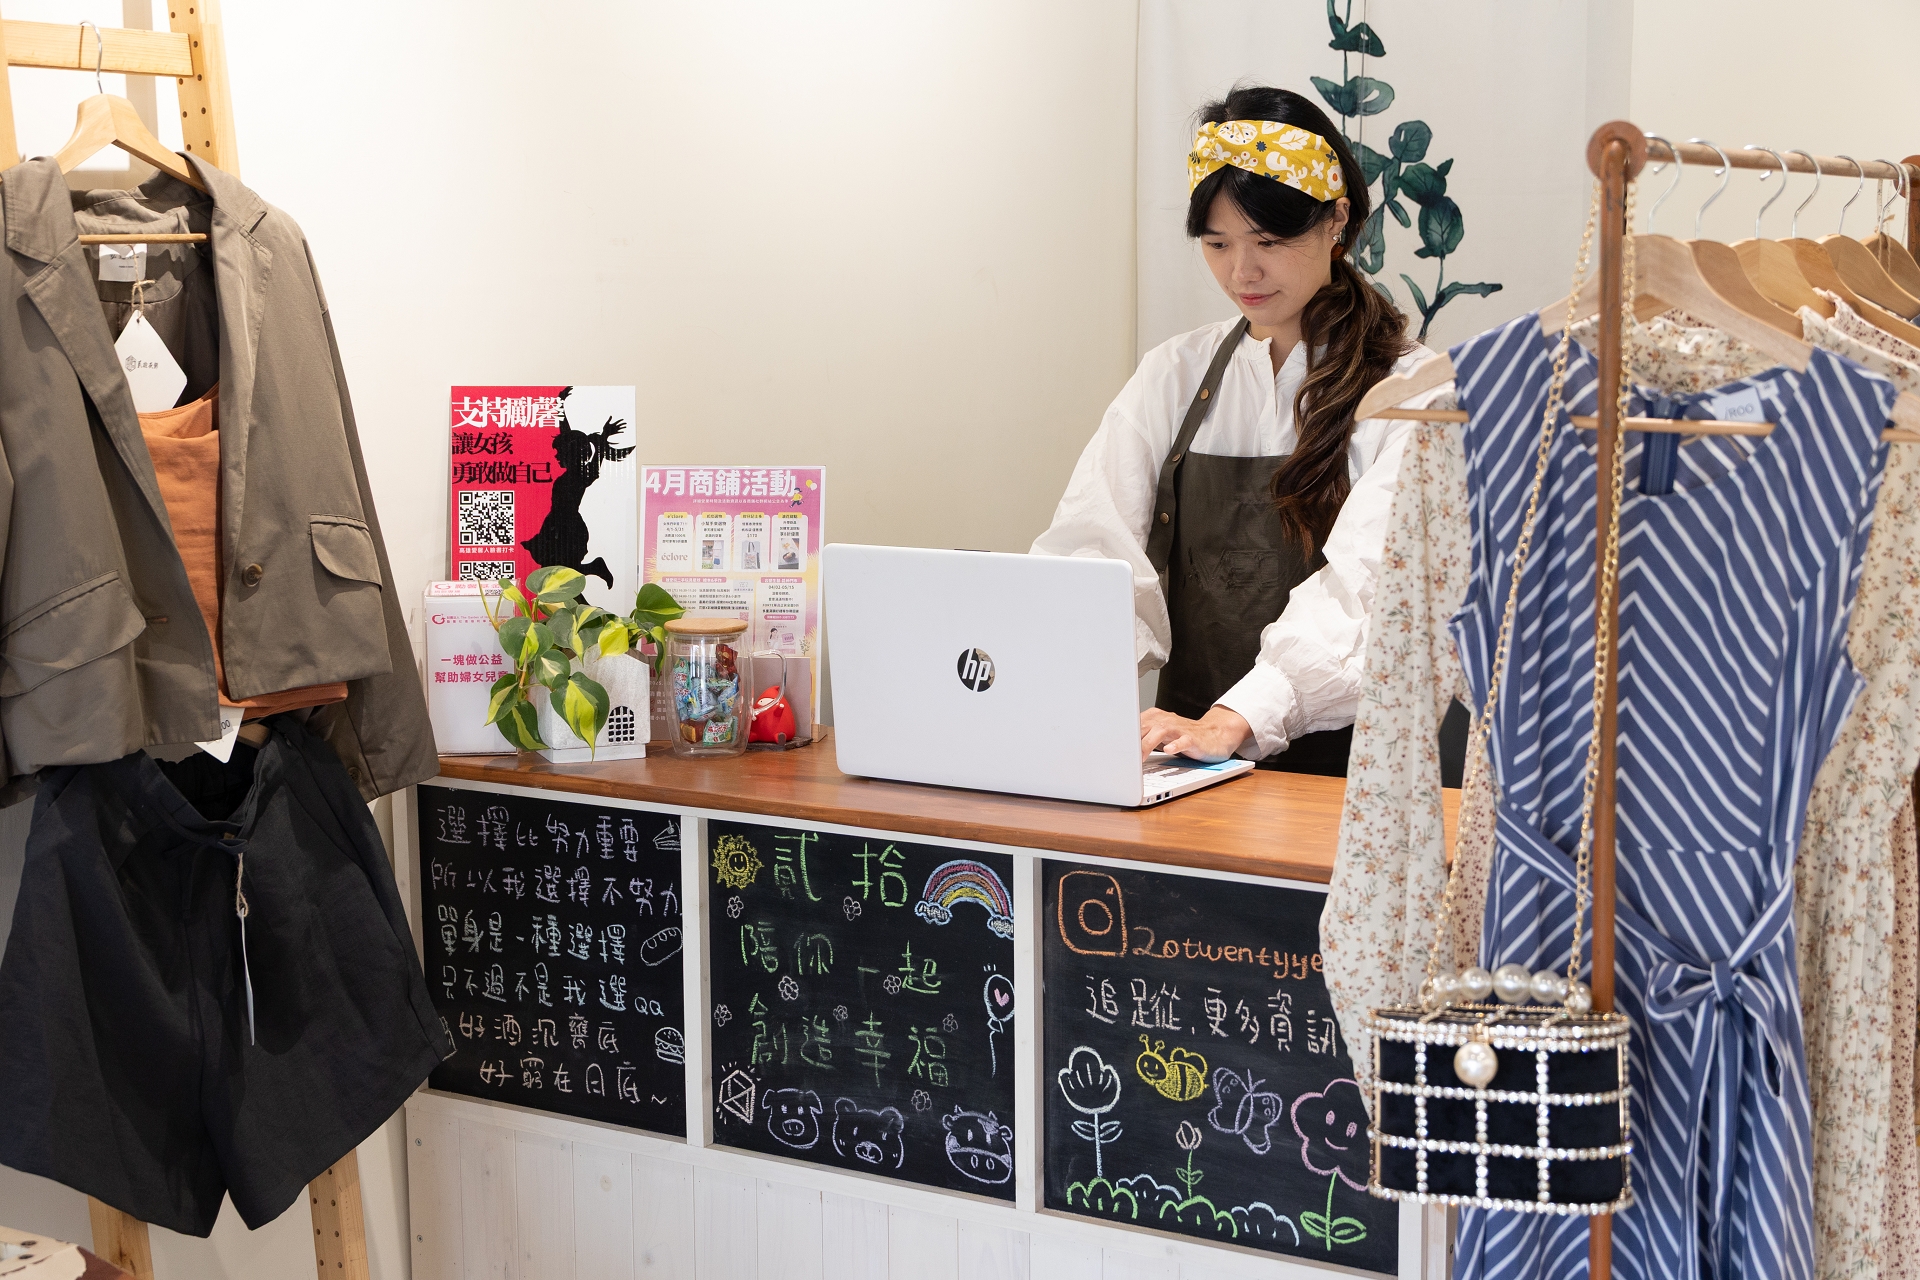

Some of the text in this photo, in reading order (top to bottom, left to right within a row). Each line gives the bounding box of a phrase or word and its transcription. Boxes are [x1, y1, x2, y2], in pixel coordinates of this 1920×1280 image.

[452, 396, 565, 428] 支持勵馨
[452, 432, 514, 455] 讓女孩
[452, 461, 553, 484] 勇敢做自己
[441, 654, 503, 666] 一塊做公益
[962, 648, 992, 692] hp
[437, 805, 639, 862] 選擇比努力重要
[431, 857, 682, 916] 所以我選擇不努力
[774, 832, 908, 907] 貳拾
[438, 904, 627, 965] 單身是一種選擇
[748, 992, 949, 1088] 創造幸福
